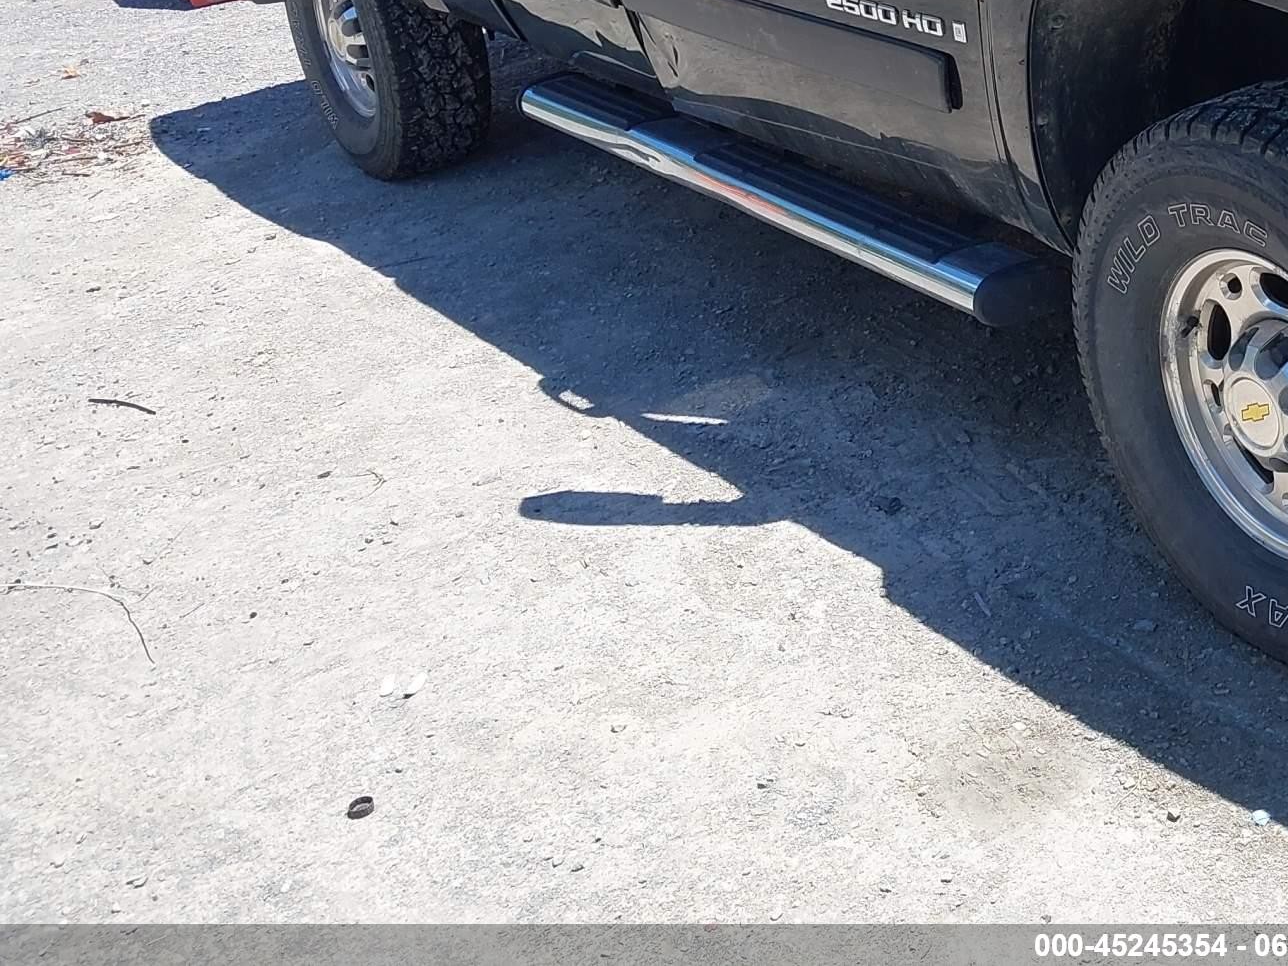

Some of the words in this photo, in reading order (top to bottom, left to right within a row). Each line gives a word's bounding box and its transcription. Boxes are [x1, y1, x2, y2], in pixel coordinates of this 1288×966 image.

[902, 9, 944, 37] HD
[1107, 215, 1161, 294] WILD
[1168, 203, 1268, 248] TRAC
